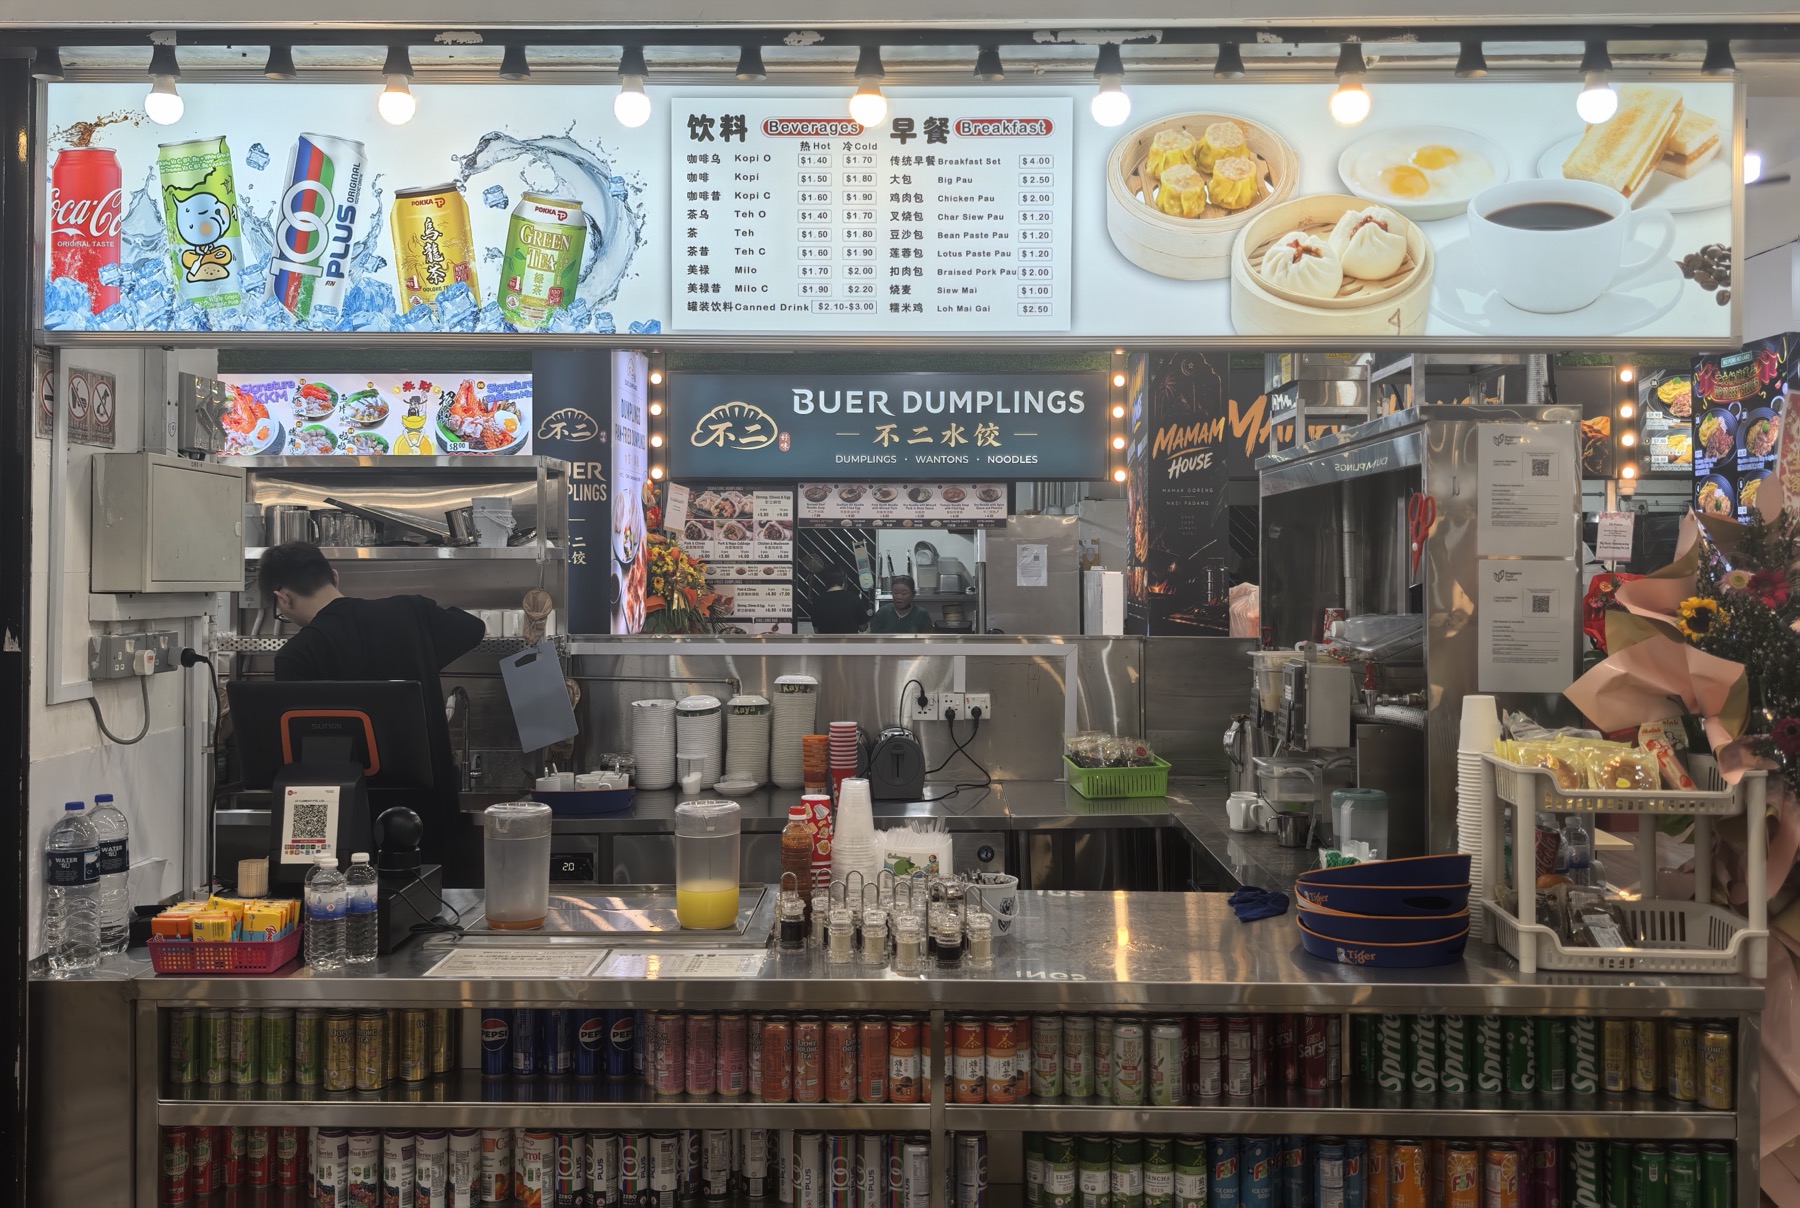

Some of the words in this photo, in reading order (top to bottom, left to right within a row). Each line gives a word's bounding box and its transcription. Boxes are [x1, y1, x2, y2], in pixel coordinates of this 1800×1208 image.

[687, 114, 748, 143] 饮料
[768, 120, 860, 138] Beverages
[890, 116, 950, 145] 早餐
[961, 121, 1046, 134] Breakfast
[813, 142, 831, 150] Hot
[855, 142, 877, 150] Cold
[735, 154, 759, 164] Kopi
[763, 155, 772, 163] O
[801, 156, 828, 165] $1.40
[846, 156, 873, 165] $1.70
[890, 155, 936, 166] 传统早餐
[938, 157, 983, 165] Breakfast
[986, 157, 1001, 165] Set
[1022, 157, 1050, 166] $4.00
[687, 172, 709, 182] 咖啡
[735, 173, 759, 182] Kopi
[801, 175, 828, 183] $1.50
[846, 175, 873, 183] $1.80
[890, 174, 912, 185] 大包
[938, 176, 953, 185] Big
[1022, 176, 1050, 184] $2.50
[347, 162, 361, 204] ORIGINAL
[735, 191, 759, 201] Kopi
[763, 192, 771, 200] C
[802, 193, 828, 202] $1.60
[846, 193, 873, 202] $1.90
[890, 192, 924, 203] 鸡肉包
[1022, 194, 1050, 203] $2.00
[411, 199, 434, 207] POKKA
[534, 206, 557, 216] POKKA
[734, 210, 754, 218] Teh
[759, 210, 767, 218] O
[801, 212, 828, 220] $1.40
[847, 212, 873, 220] $1.70
[890, 211, 923, 222] 叉烧包
[1022, 213, 1049, 221] $1.20
[270, 180, 334, 279] 100
[687, 228, 698, 238] 茶
[734, 229, 754, 237] Teh
[520, 224, 572, 252] GREEN
[802, 230, 828, 239] $1.50
[847, 230, 873, 239] $1.80
[890, 229, 923, 240] 豆沙包
[1022, 232, 1049, 240] $1.20
[58, 241, 91, 249] ORIGINAL
[326, 204, 357, 279] PLUS
[802, 249, 828, 257] $1.60
[847, 249, 873, 257] $1.90
[1022, 250, 1049, 258] $1.20
[527, 247, 557, 273] TEA
[735, 266, 757, 274] Milo
[802, 267, 829, 276] $1.70
[848, 267, 873, 276] $2.00
[937, 268, 972, 276] Braised
[976, 268, 996, 276] Pork
[1000, 268, 1017, 276] Pau
[1022, 269, 1049, 277] $2.00
[735, 284, 757, 293] Milo
[761, 285, 769, 293] C
[802, 286, 829, 294] $1.90
[848, 286, 873, 294] $2.20
[890, 284, 911, 295] 烧麦
[1022, 287, 1048, 295] $1.00
[735, 303, 776, 311] Canned
[780, 303, 810, 311] Drink
[818, 303, 874, 311] $2.10-$3.00
[1023, 305, 1048, 313] $2.50
[253, 391, 288, 404] KKM
[792, 388, 896, 417] BUER
[903, 390, 1086, 414] DUMPLINGS
[548, 422, 592, 441] 不二
[708, 423, 767, 448] 不二
[872, 422, 1002, 448] 不二水饺
[1152, 416, 1226, 459] MAMAM
[835, 455, 897, 465] DUMPLINGS
[915, 455, 969, 464] WANTONS
[987, 455, 1038, 464] NOODLES
[1168, 452, 1214, 480] HOUSE
[569, 462, 608, 482] ER
[569, 484, 608, 502] PLINGS
[1309, 891, 1329, 905] Tiger
[1347, 949, 1376, 964] Tiger
[1298, 1039, 1326, 1058] Sarsi
[1378, 1015, 1402, 1093] Sprite
[1412, 1015, 1437, 1093] Sprite
[1440, 1015, 1469, 1093] Sprite
[1478, 1015, 1502, 1093] Sprite
[1452, 1174, 1475, 1193] F&N
